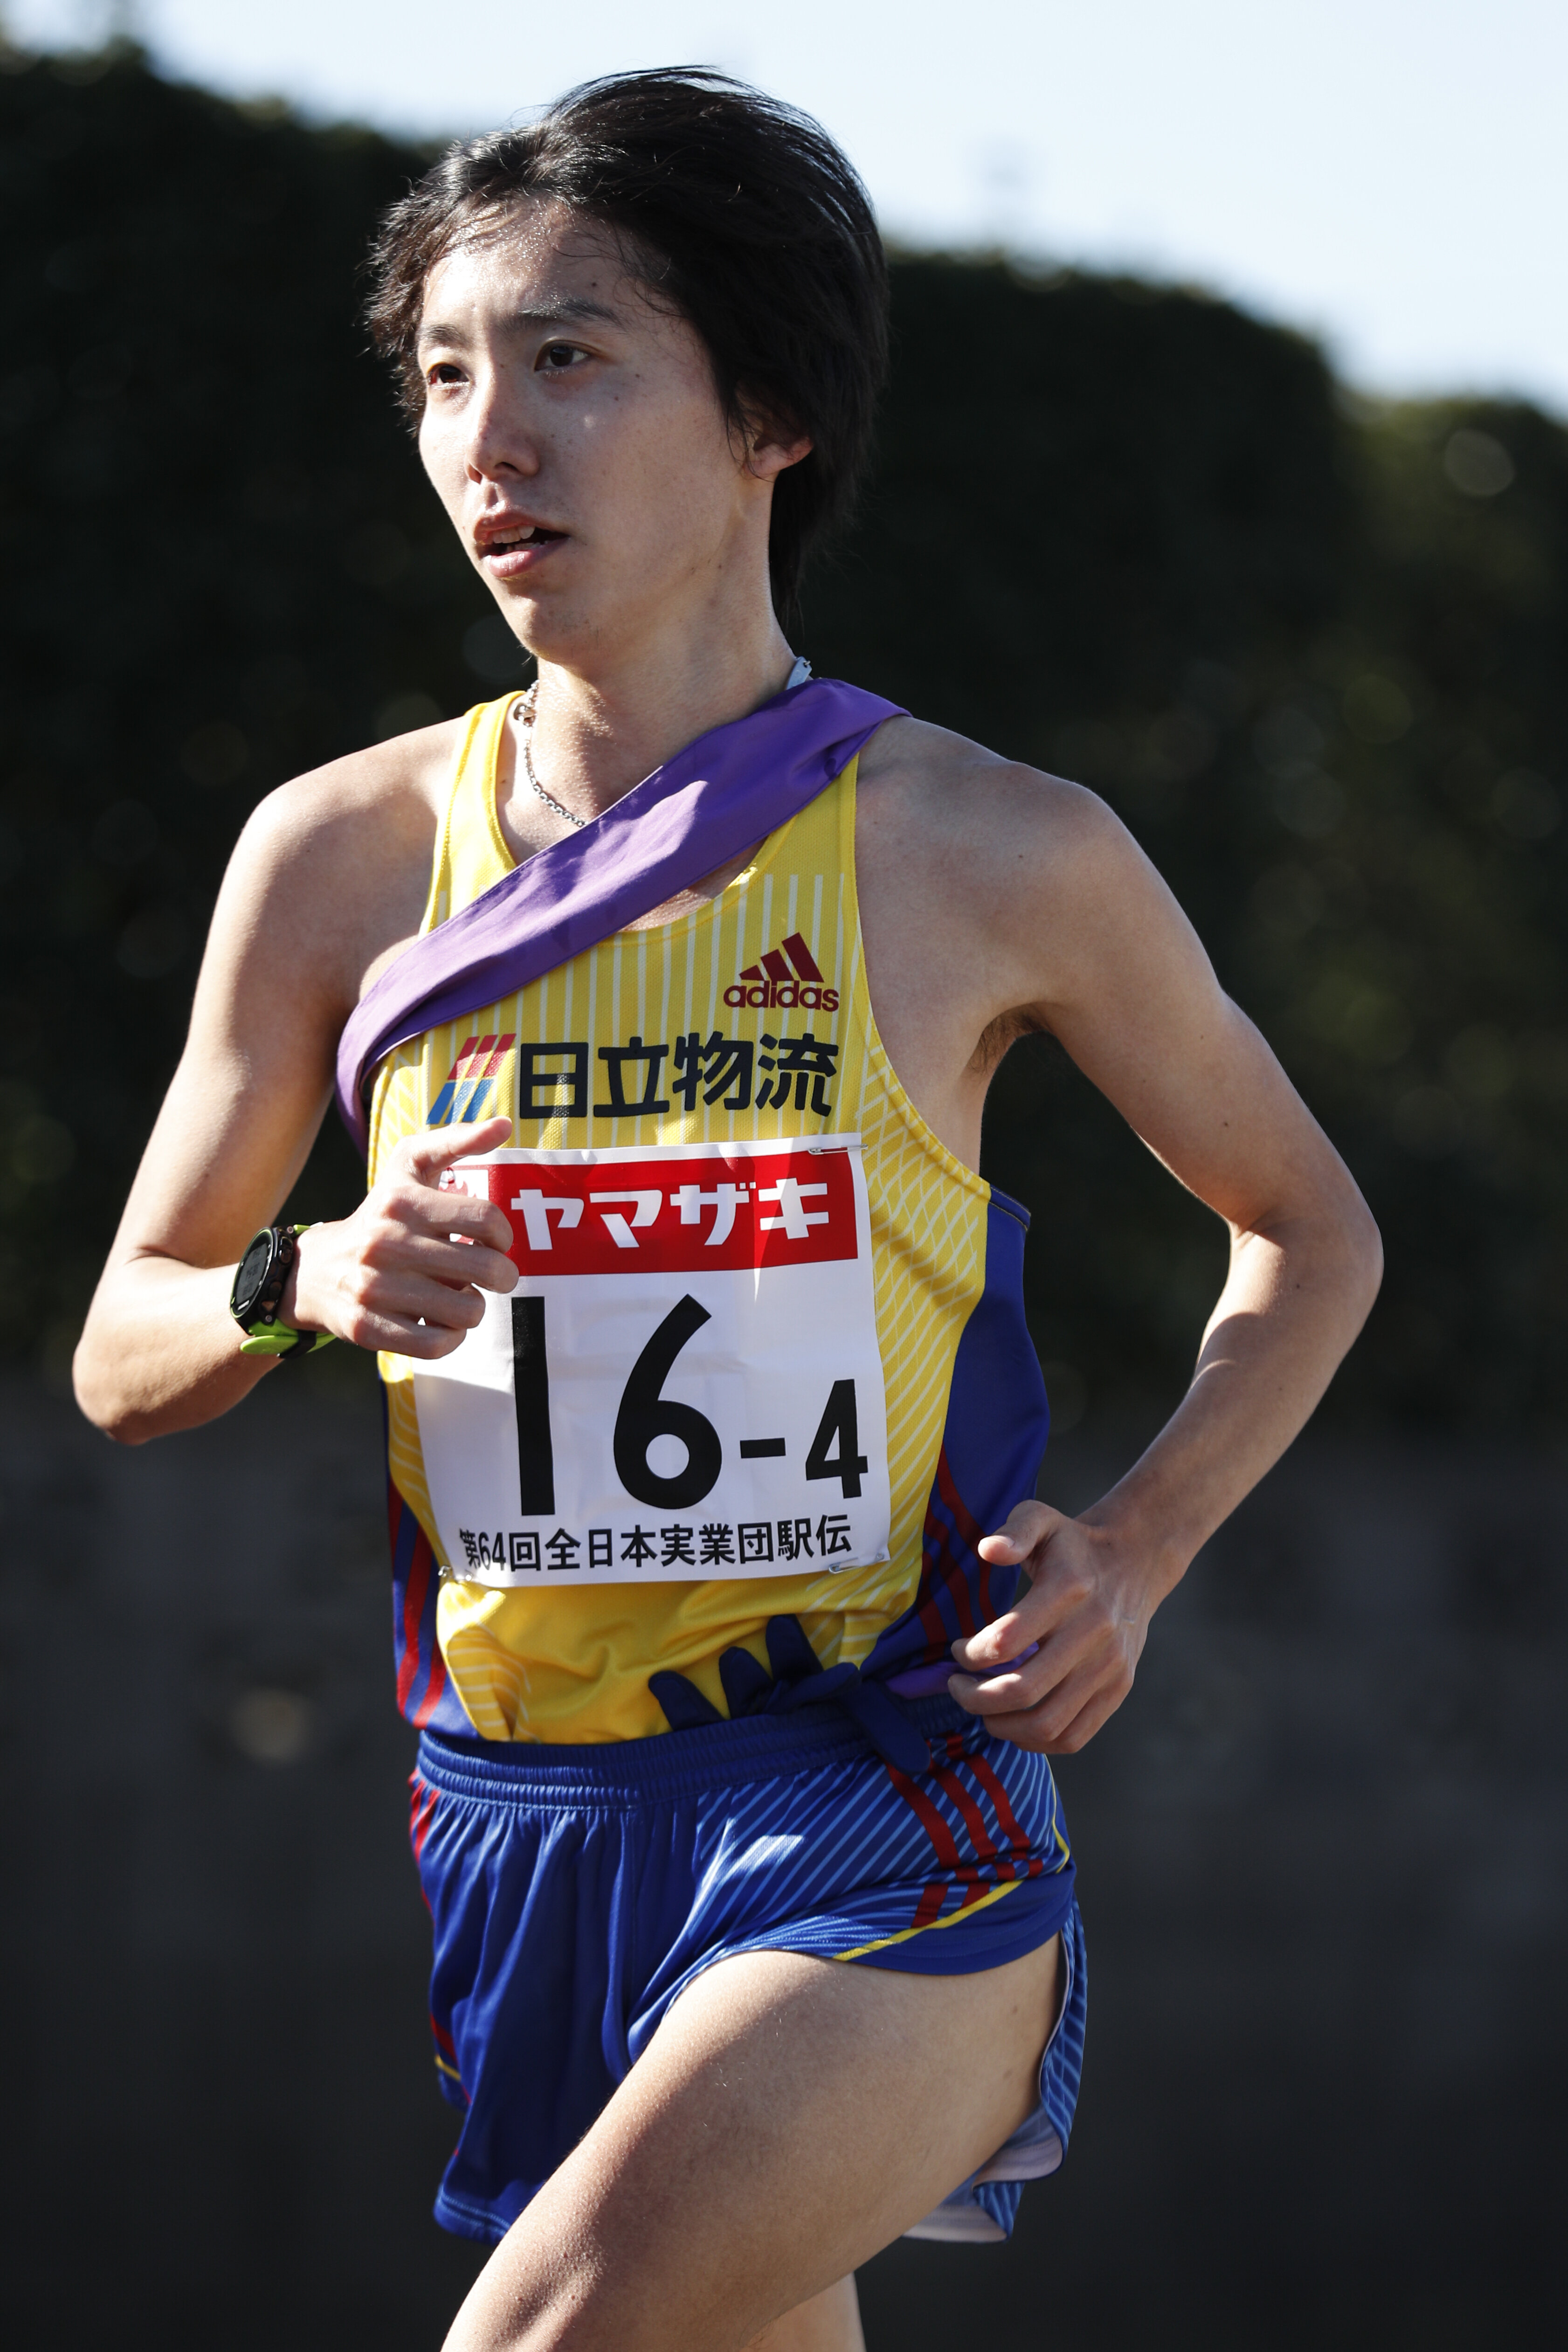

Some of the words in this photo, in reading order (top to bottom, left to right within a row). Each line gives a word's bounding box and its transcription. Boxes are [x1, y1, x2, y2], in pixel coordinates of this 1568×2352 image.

[723, 980, 839, 1012] adidas
[518, 1031, 839, 1119] 日立物流
[511, 1178, 829, 1250] ヤマザキ
[511, 1293, 868, 1516] 16-4
[459, 1514, 852, 1572] 第64回全日本実業団駅伝
